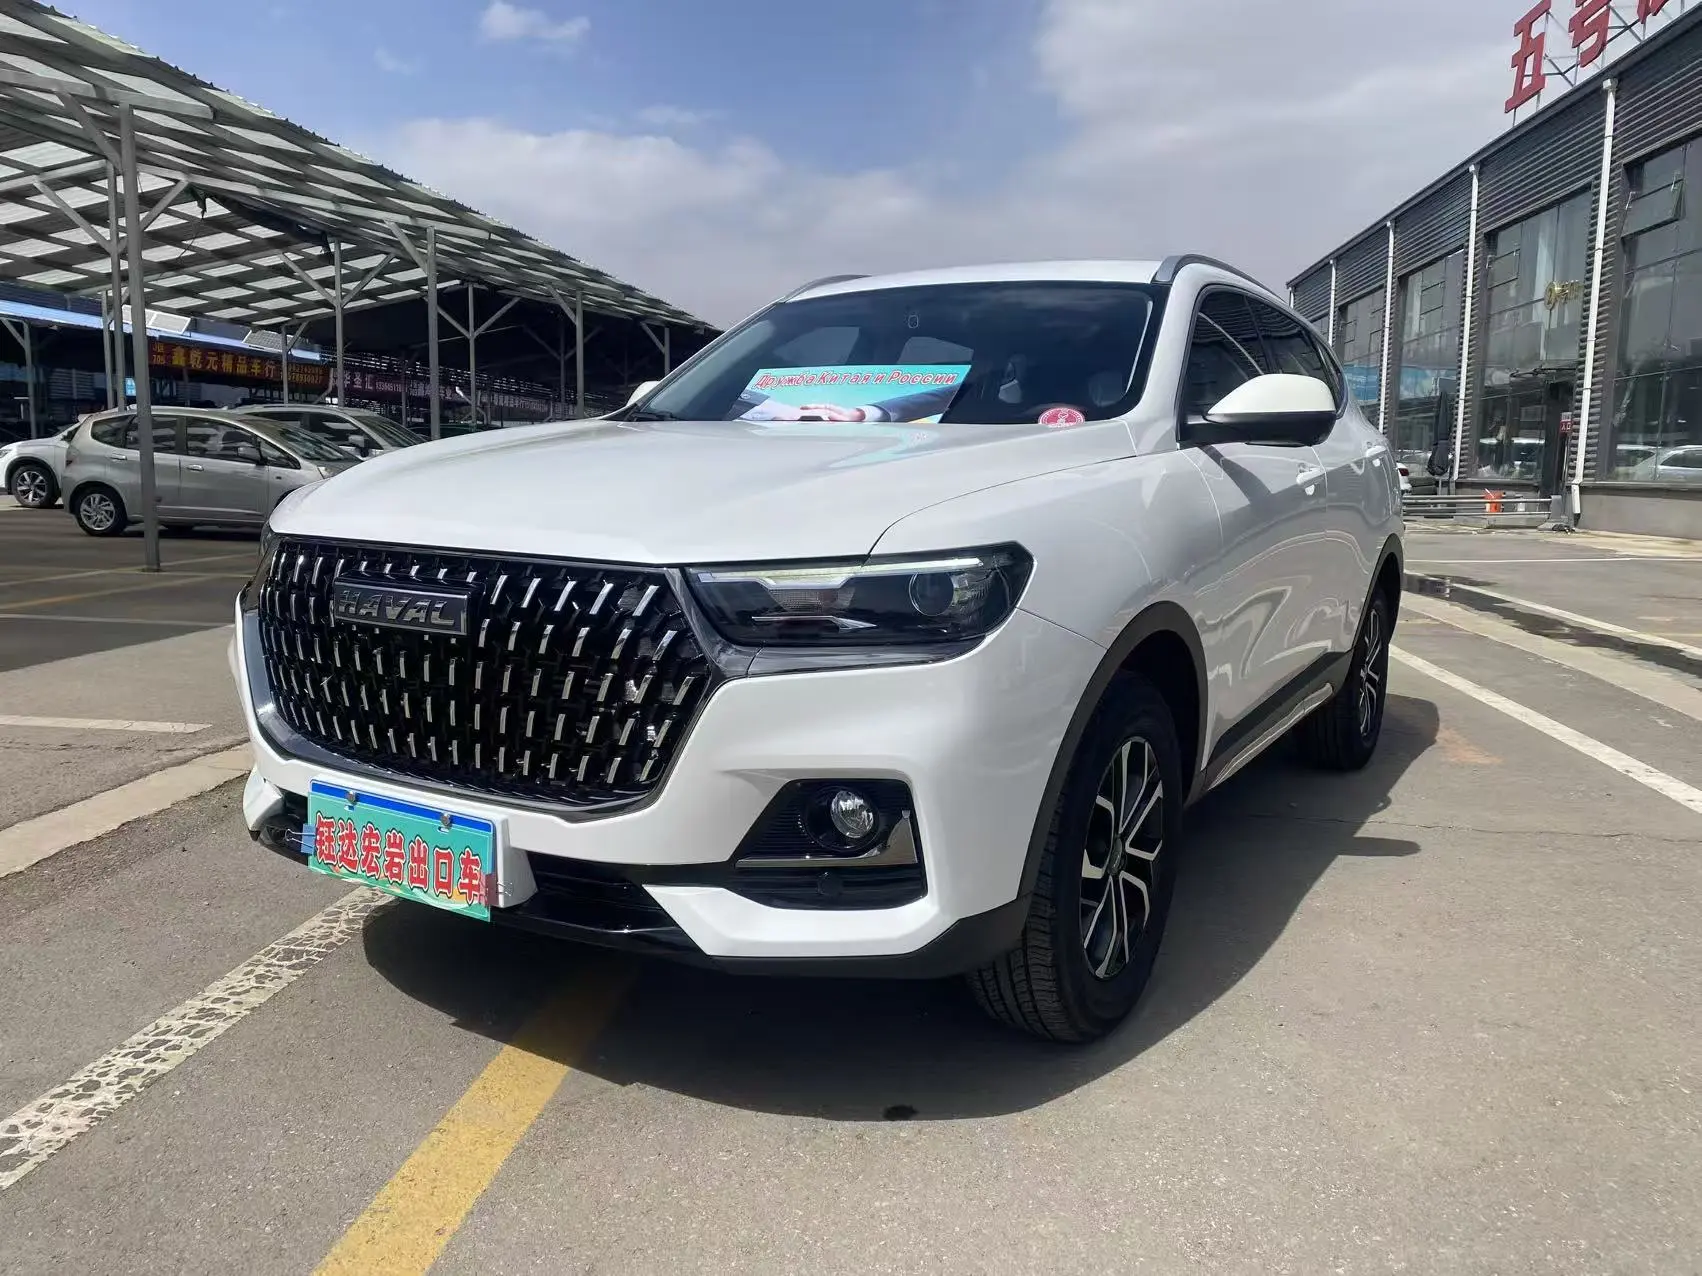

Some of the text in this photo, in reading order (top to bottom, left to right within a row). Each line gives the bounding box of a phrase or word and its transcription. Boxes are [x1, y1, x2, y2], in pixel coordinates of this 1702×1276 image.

[754, 369, 957, 390] Дружба Китая и России
[339, 589, 454, 627] HAVAL
